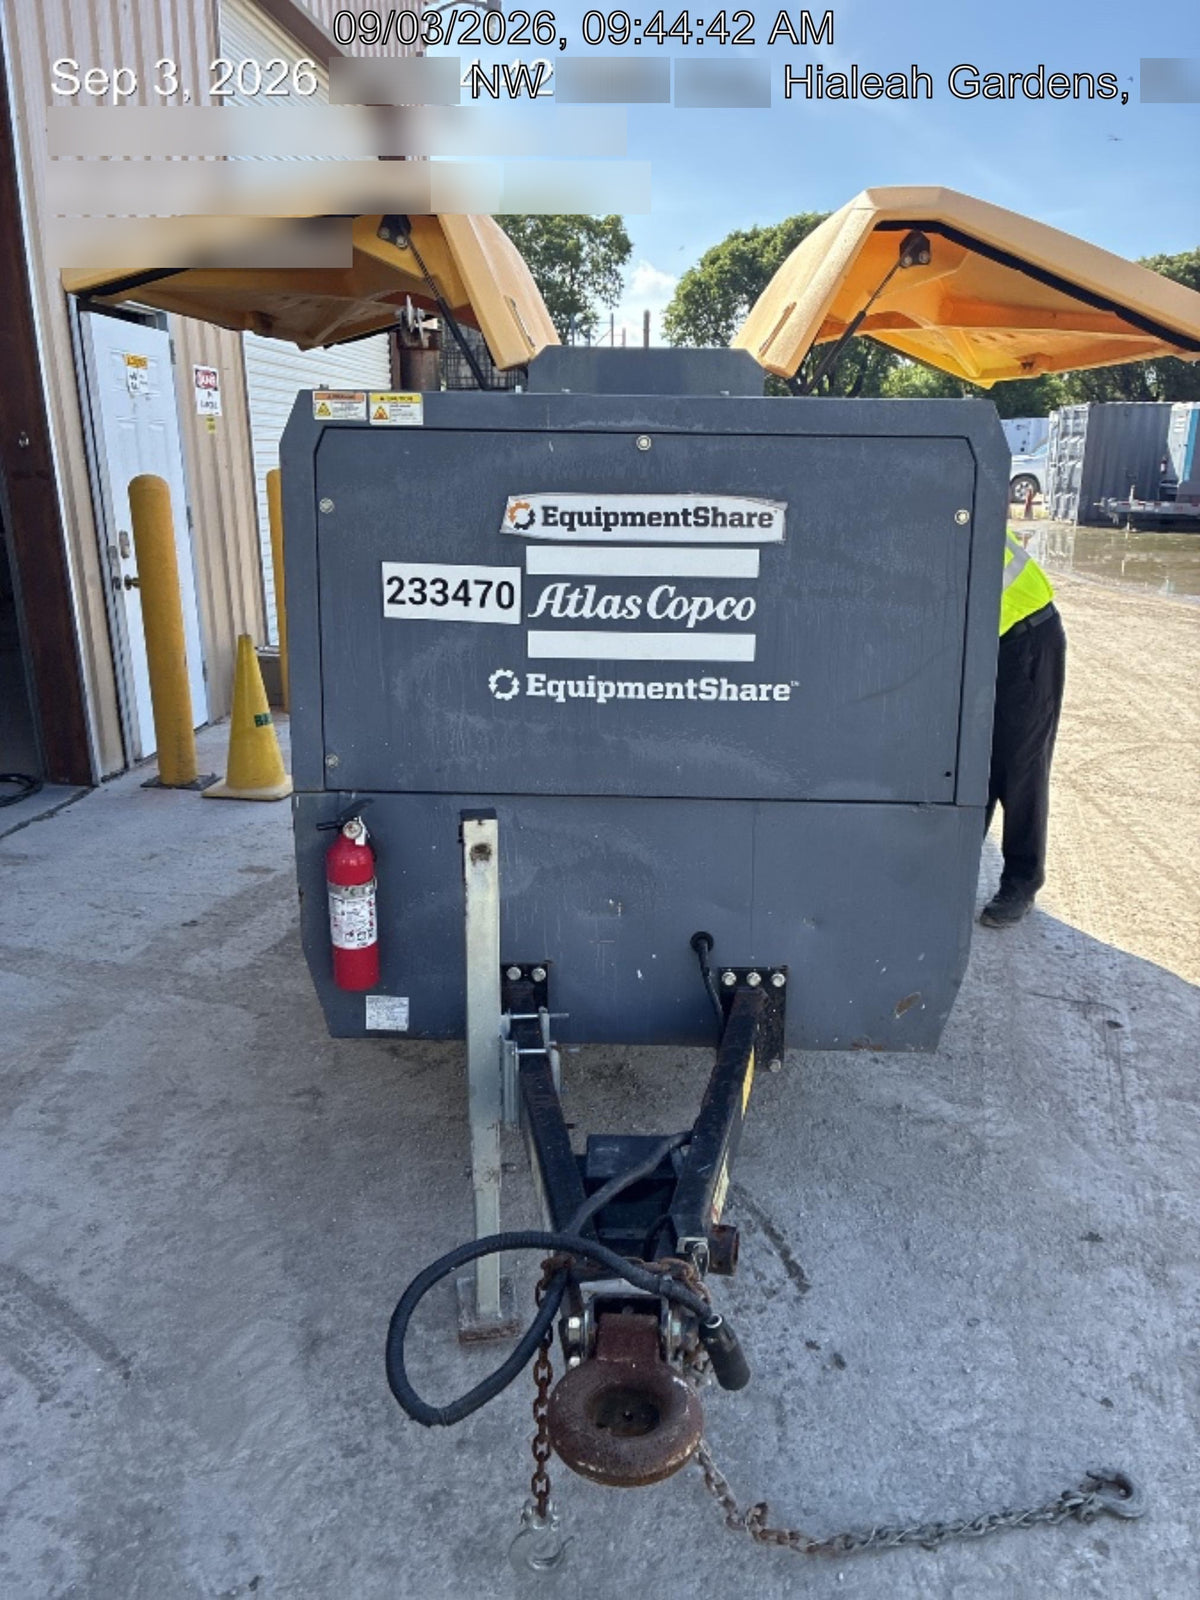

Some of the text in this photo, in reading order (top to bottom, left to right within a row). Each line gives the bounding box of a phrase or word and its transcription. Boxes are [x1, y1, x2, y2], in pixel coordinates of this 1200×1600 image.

[541, 505, 773, 532] EquipmentShare
[386, 576, 515, 609] 233470
[527, 582, 757, 629] Atlas Copco
